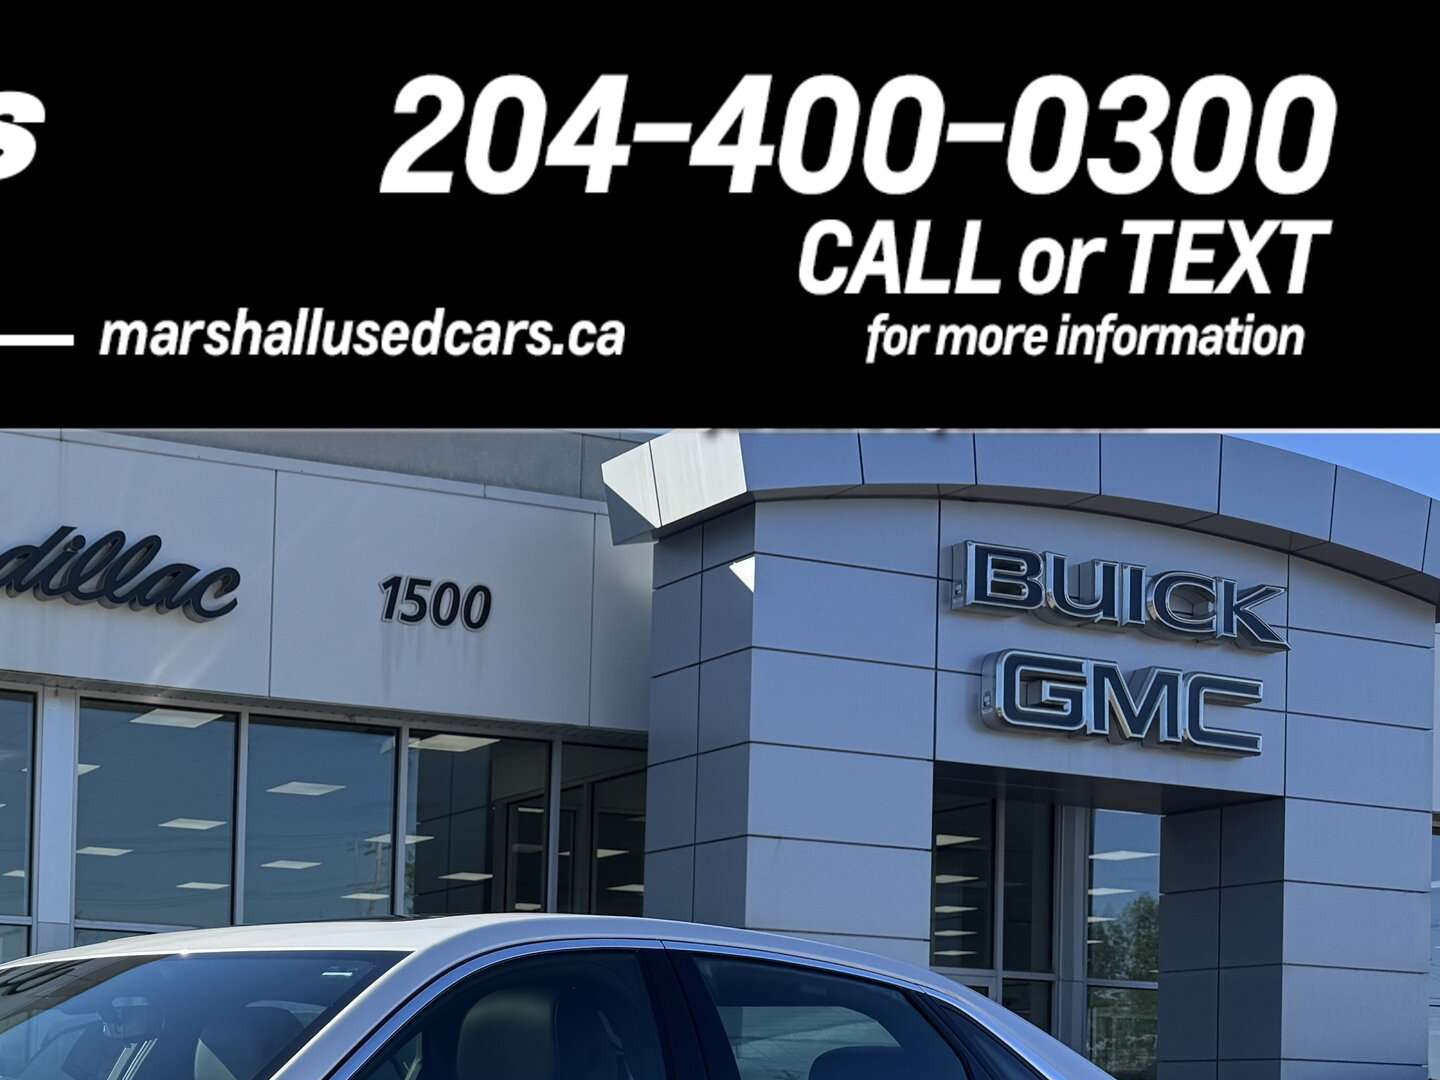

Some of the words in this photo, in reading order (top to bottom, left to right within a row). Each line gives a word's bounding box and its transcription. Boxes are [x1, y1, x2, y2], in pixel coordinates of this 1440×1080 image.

[379, 576, 492, 631] 1500
[954, 540, 1290, 651] BUICK
[984, 648, 1263, 756] GMC
